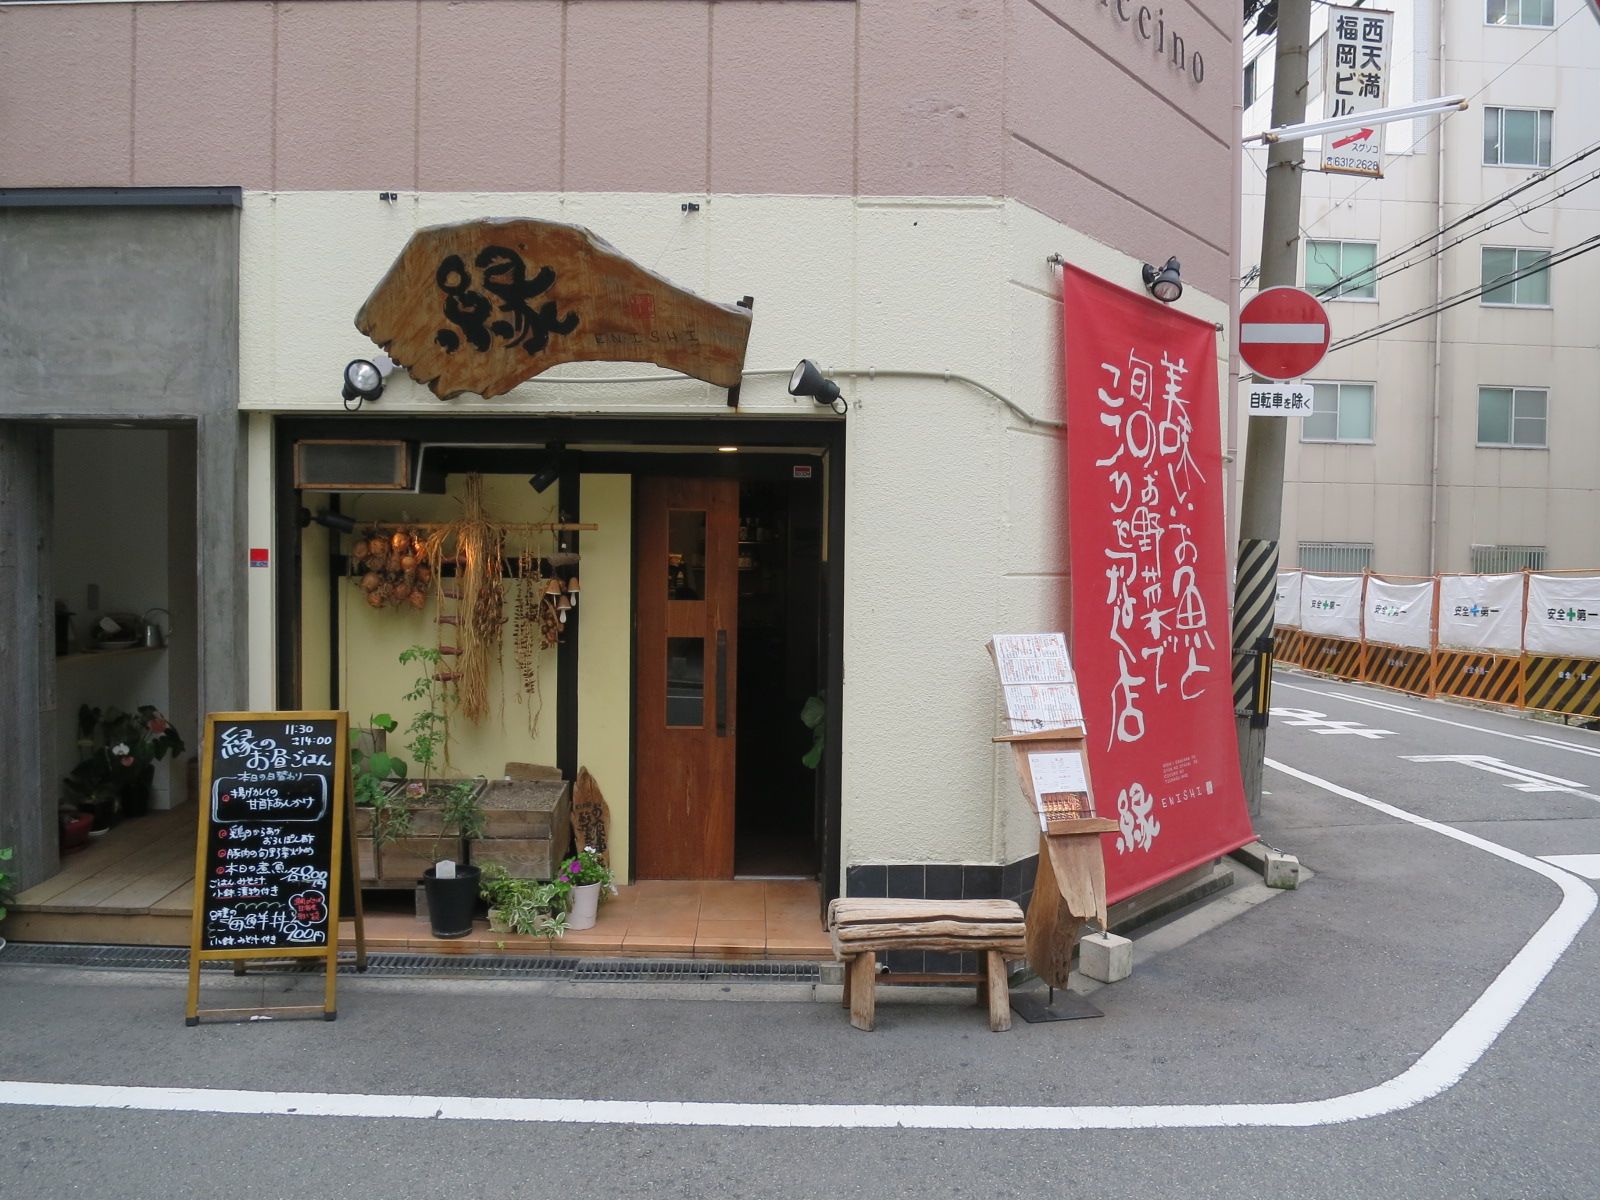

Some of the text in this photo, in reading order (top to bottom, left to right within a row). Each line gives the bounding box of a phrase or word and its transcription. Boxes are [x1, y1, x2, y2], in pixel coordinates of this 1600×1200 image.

[1100, 0, 1204, 84] ccino
[1332, 14, 1359, 118] 福岡ビル
[1359, 17, 1384, 99] 西天満
[1351, 143, 1379, 154] スグソコ
[1250, 392, 1311, 410] 自転車を除く
[285, 724, 314, 735] 11:30
[221, 726, 276, 759] 縁の
[246, 748, 332, 771] お昼ごはん
[246, 796, 315, 810] 甘酢あんかけ
[1161, 786, 1203, 809] ENISHI
